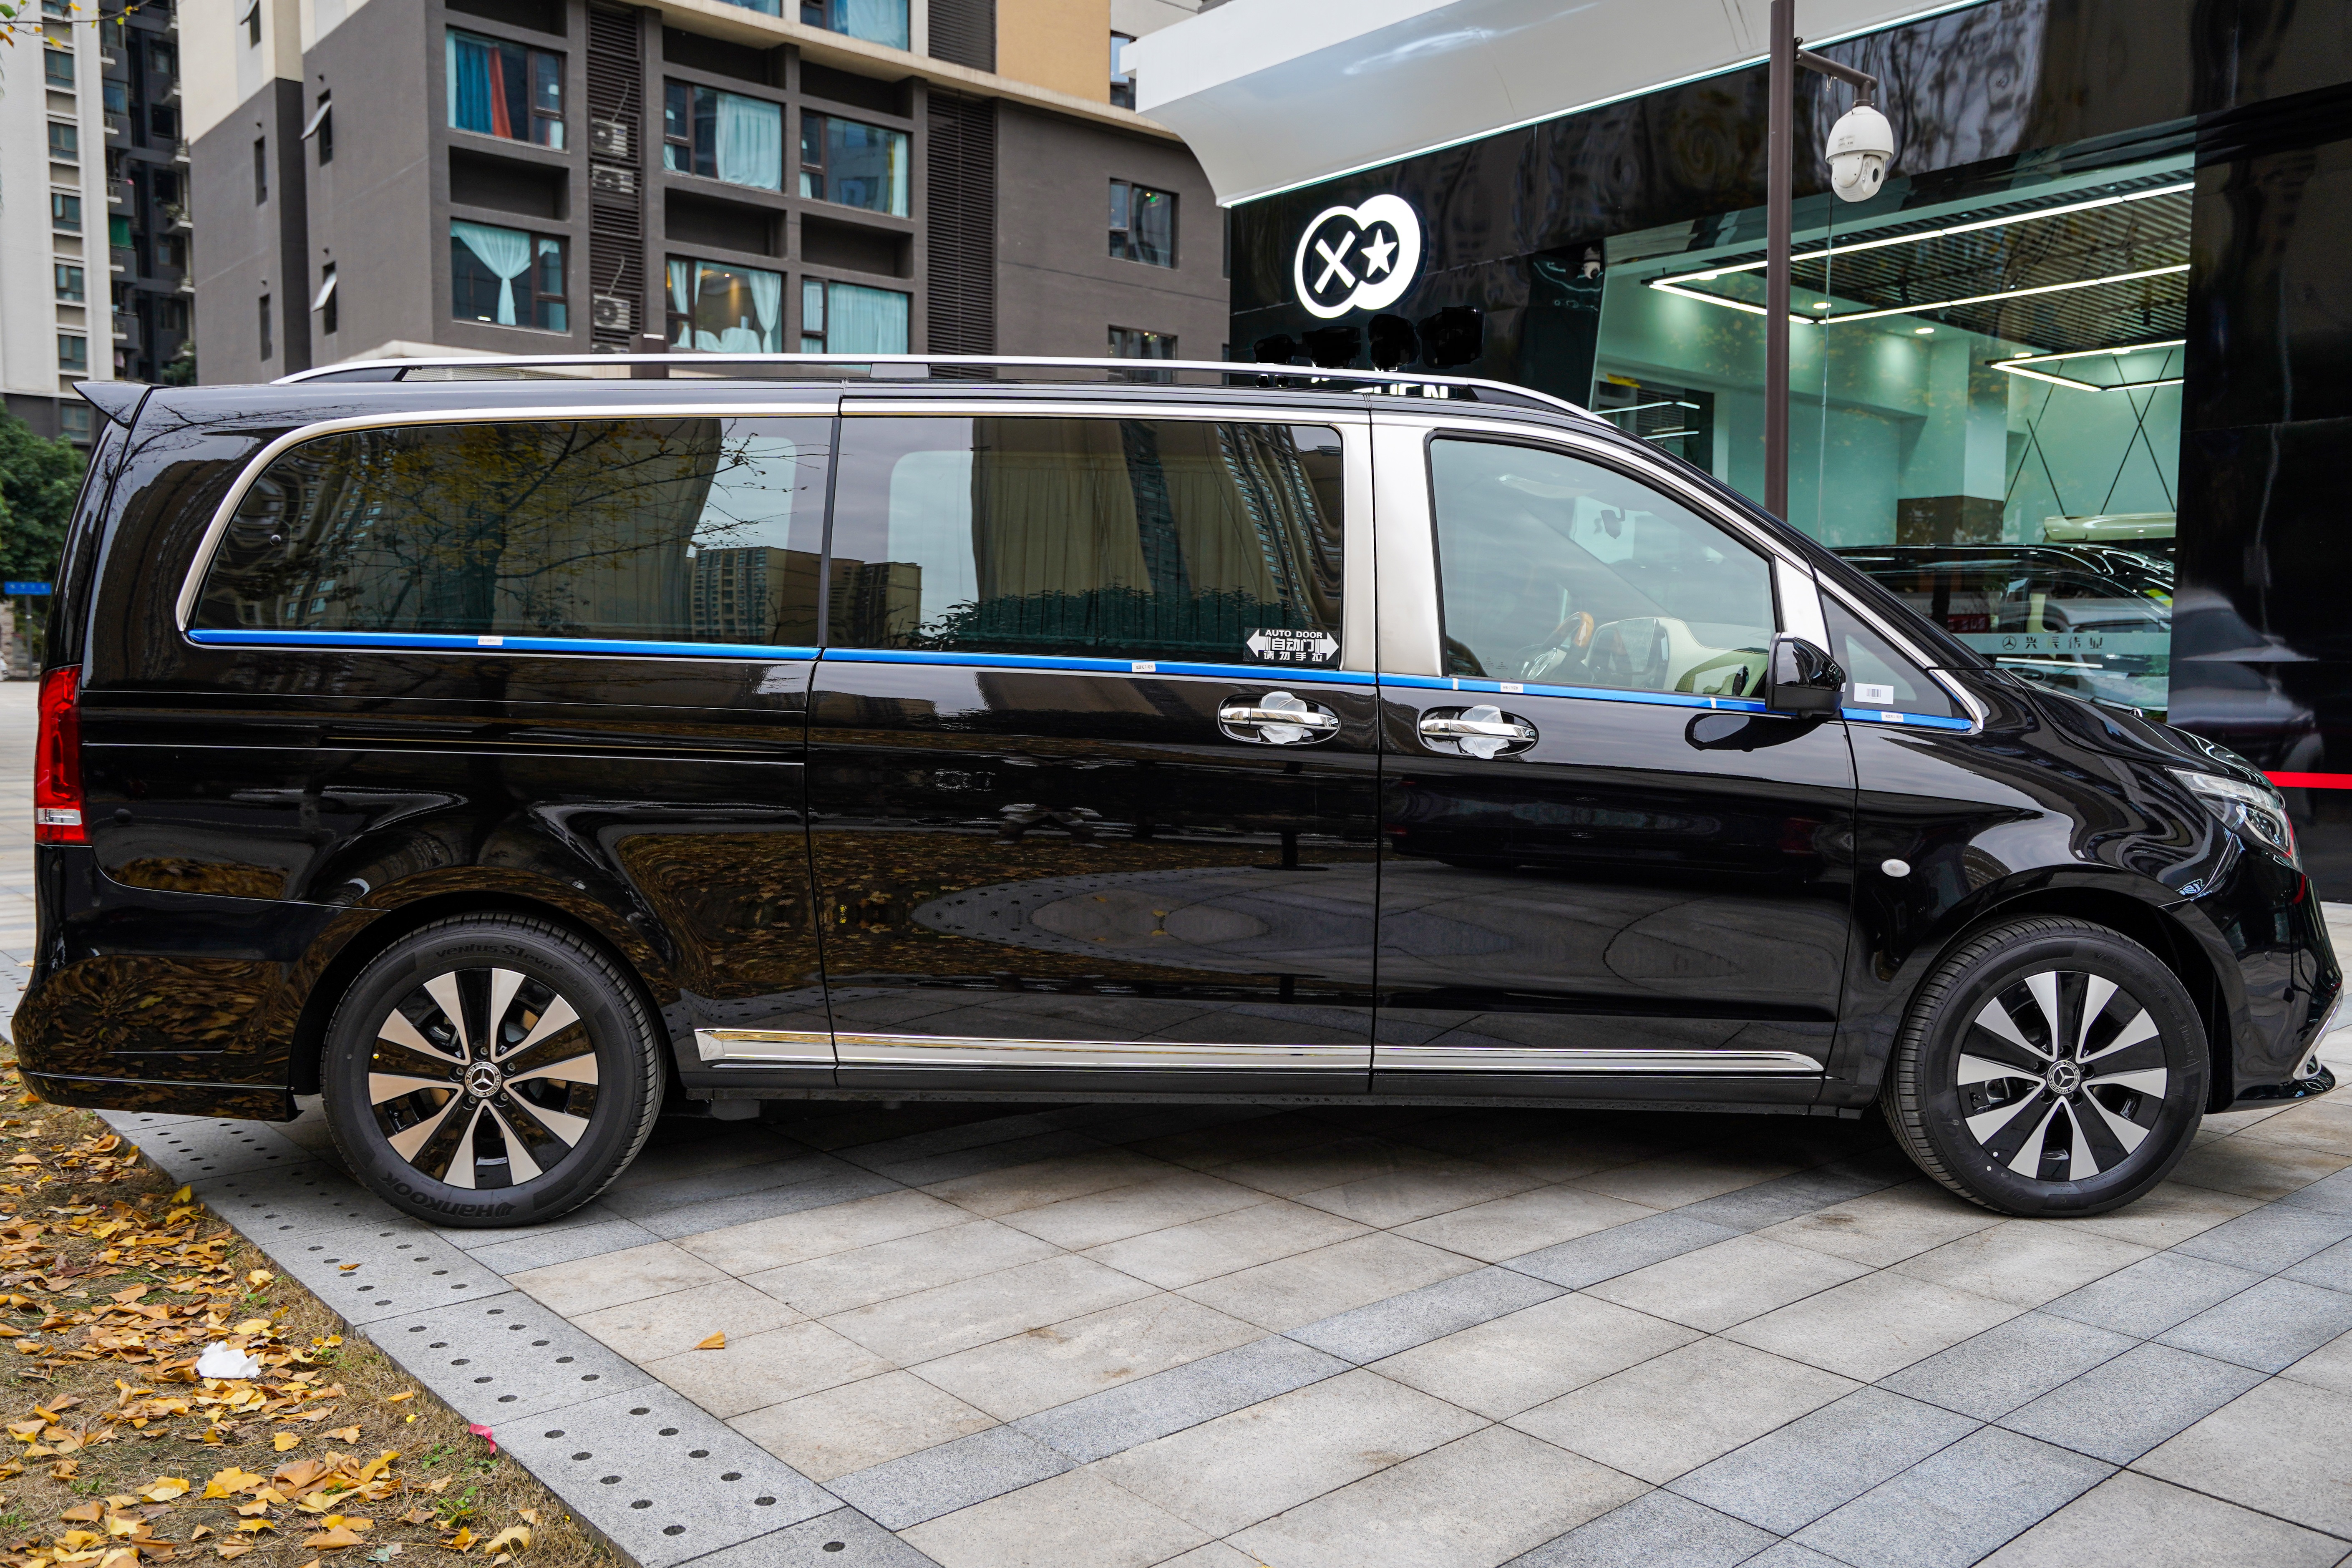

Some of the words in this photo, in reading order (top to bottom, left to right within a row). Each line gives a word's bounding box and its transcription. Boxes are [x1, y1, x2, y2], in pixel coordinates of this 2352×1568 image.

[1272, 637, 1315, 652] 自动门
[1264, 650, 1322, 662] 请勿手拉
[2049, 1080, 2068, 1093] MERCEDES
